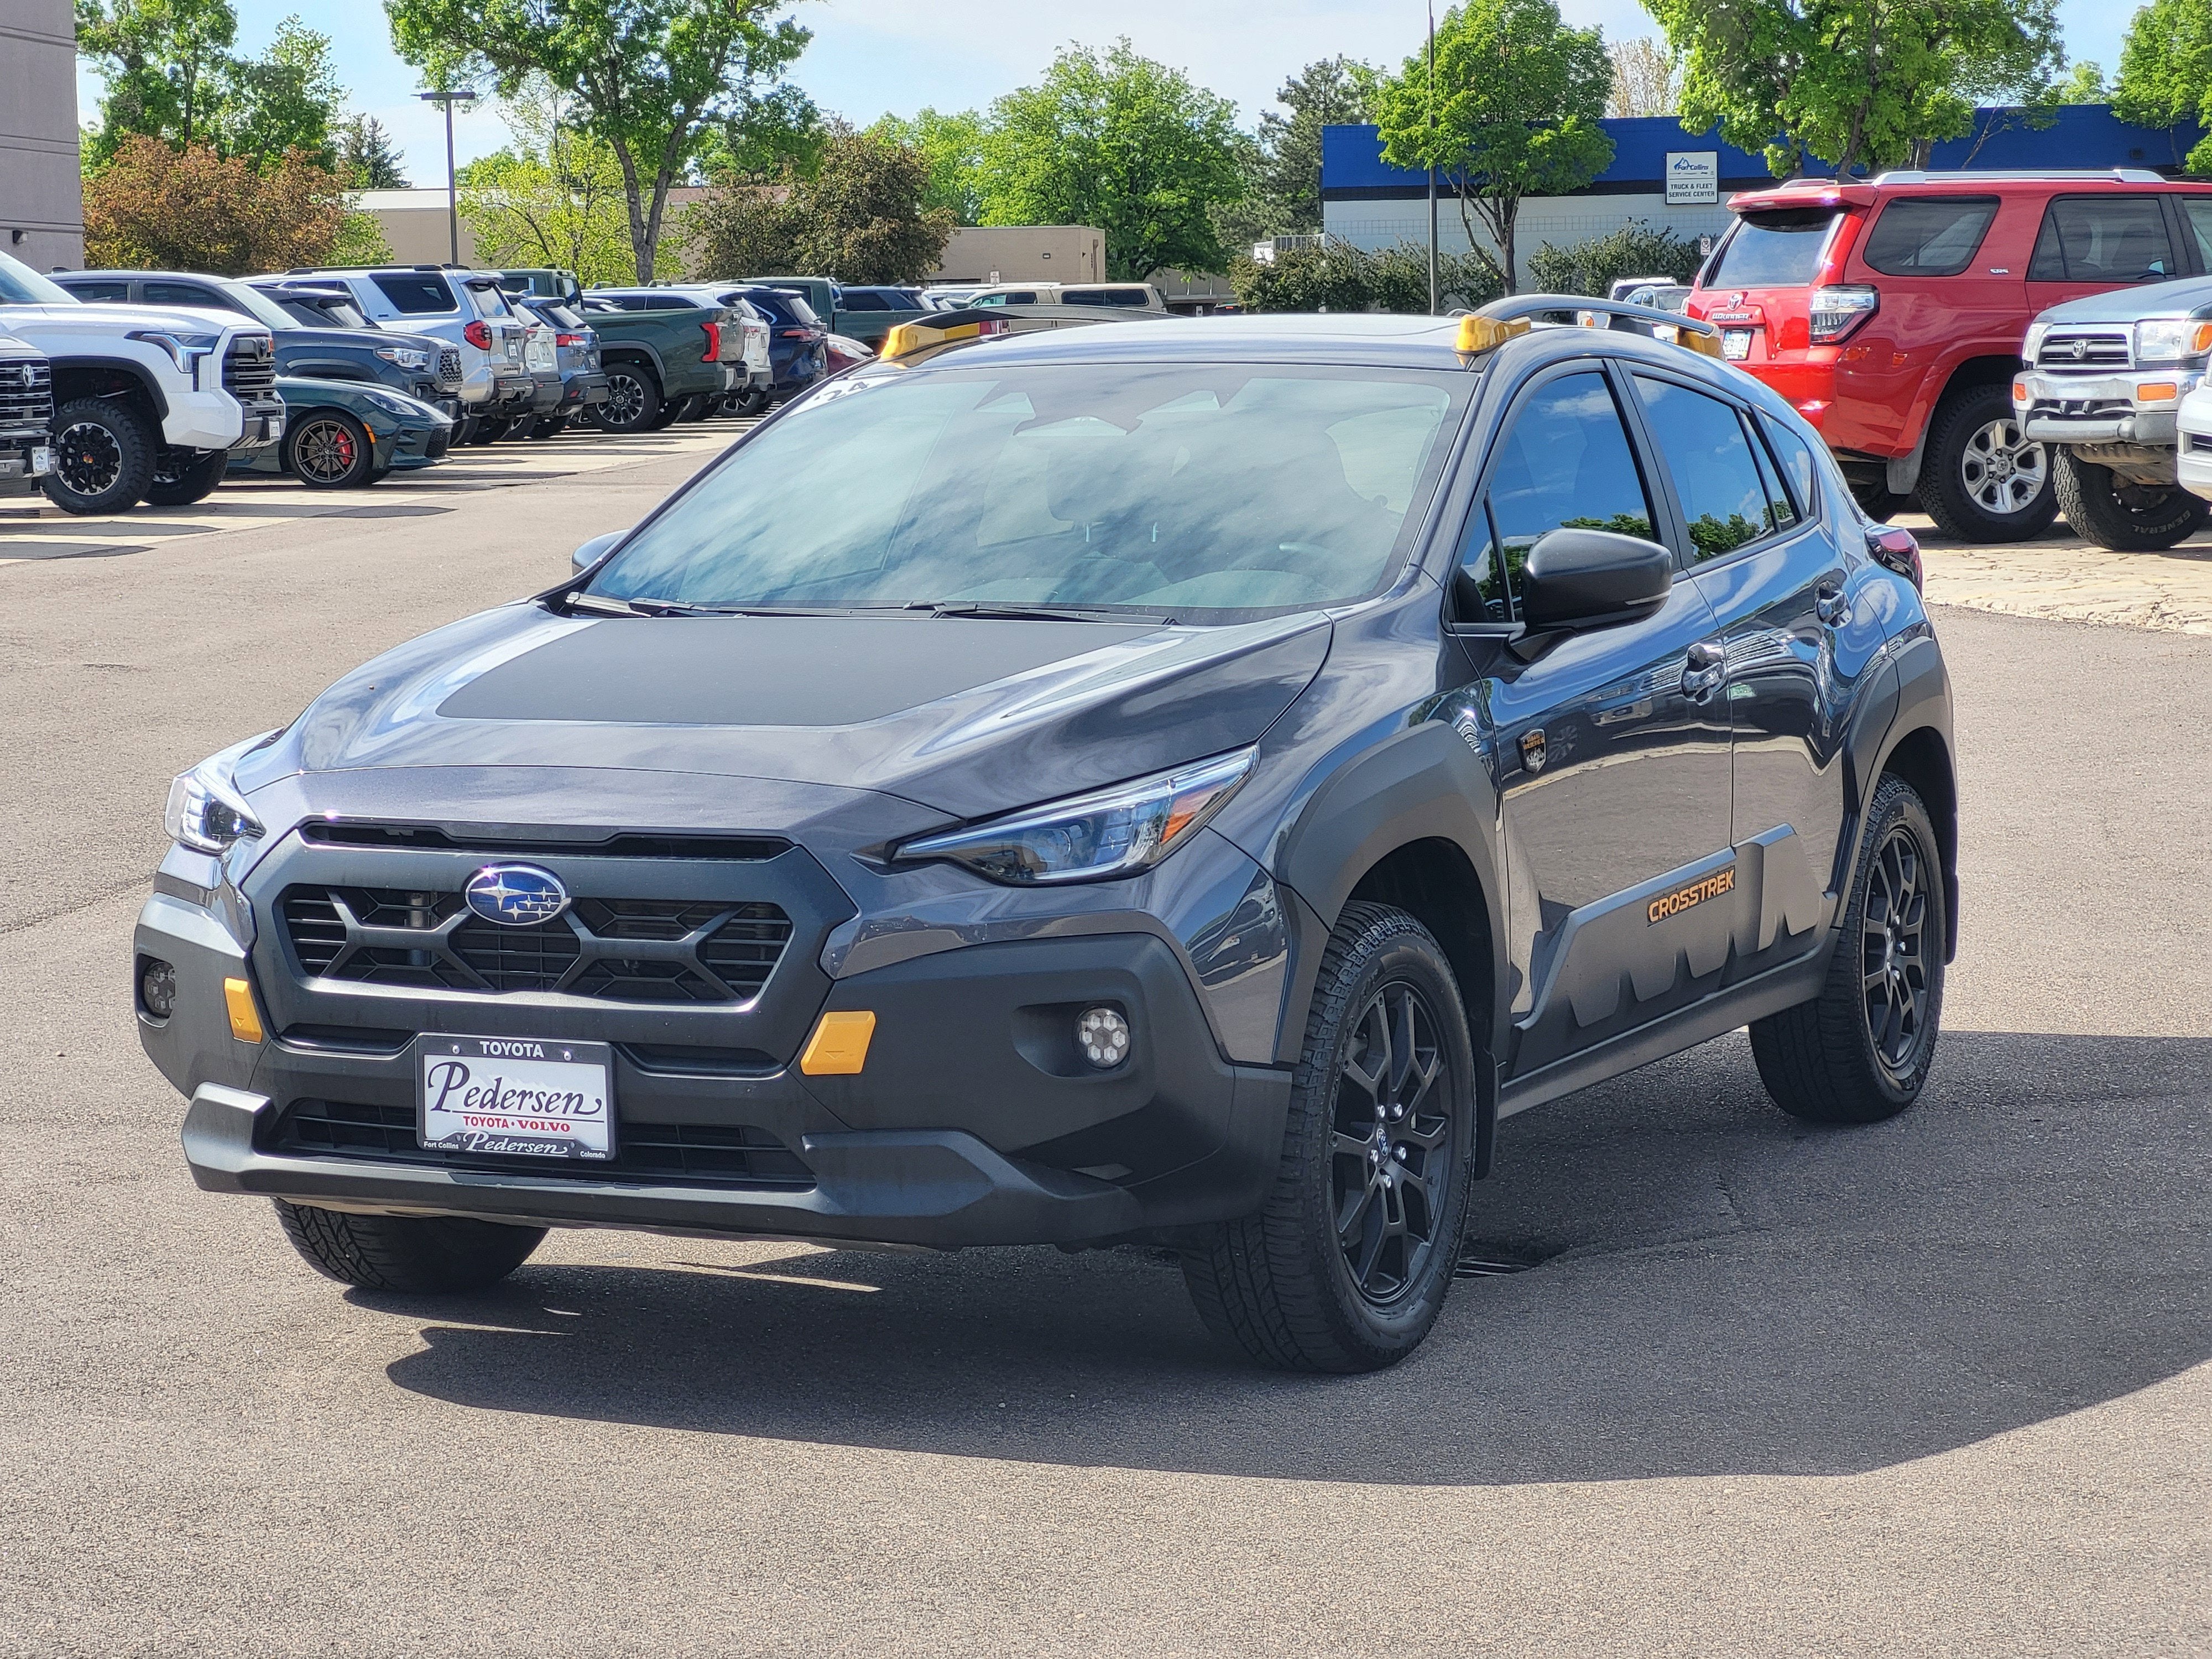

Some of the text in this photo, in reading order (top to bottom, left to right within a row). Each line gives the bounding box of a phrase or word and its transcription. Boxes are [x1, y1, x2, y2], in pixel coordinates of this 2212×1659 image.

[2131, 510, 2191, 534] GENERAL
[1648, 869, 1735, 922] CROSSTREK
[479, 1040, 545, 1058] TOYOTA
[427, 1061, 603, 1115] Pedersen
[463, 1115, 571, 1133] TOYOTA VOLVO
[438, 1141, 459, 1150] Collins
[463, 1130, 568, 1155] Pedersen
[580, 1151, 606, 1159] Colorado
